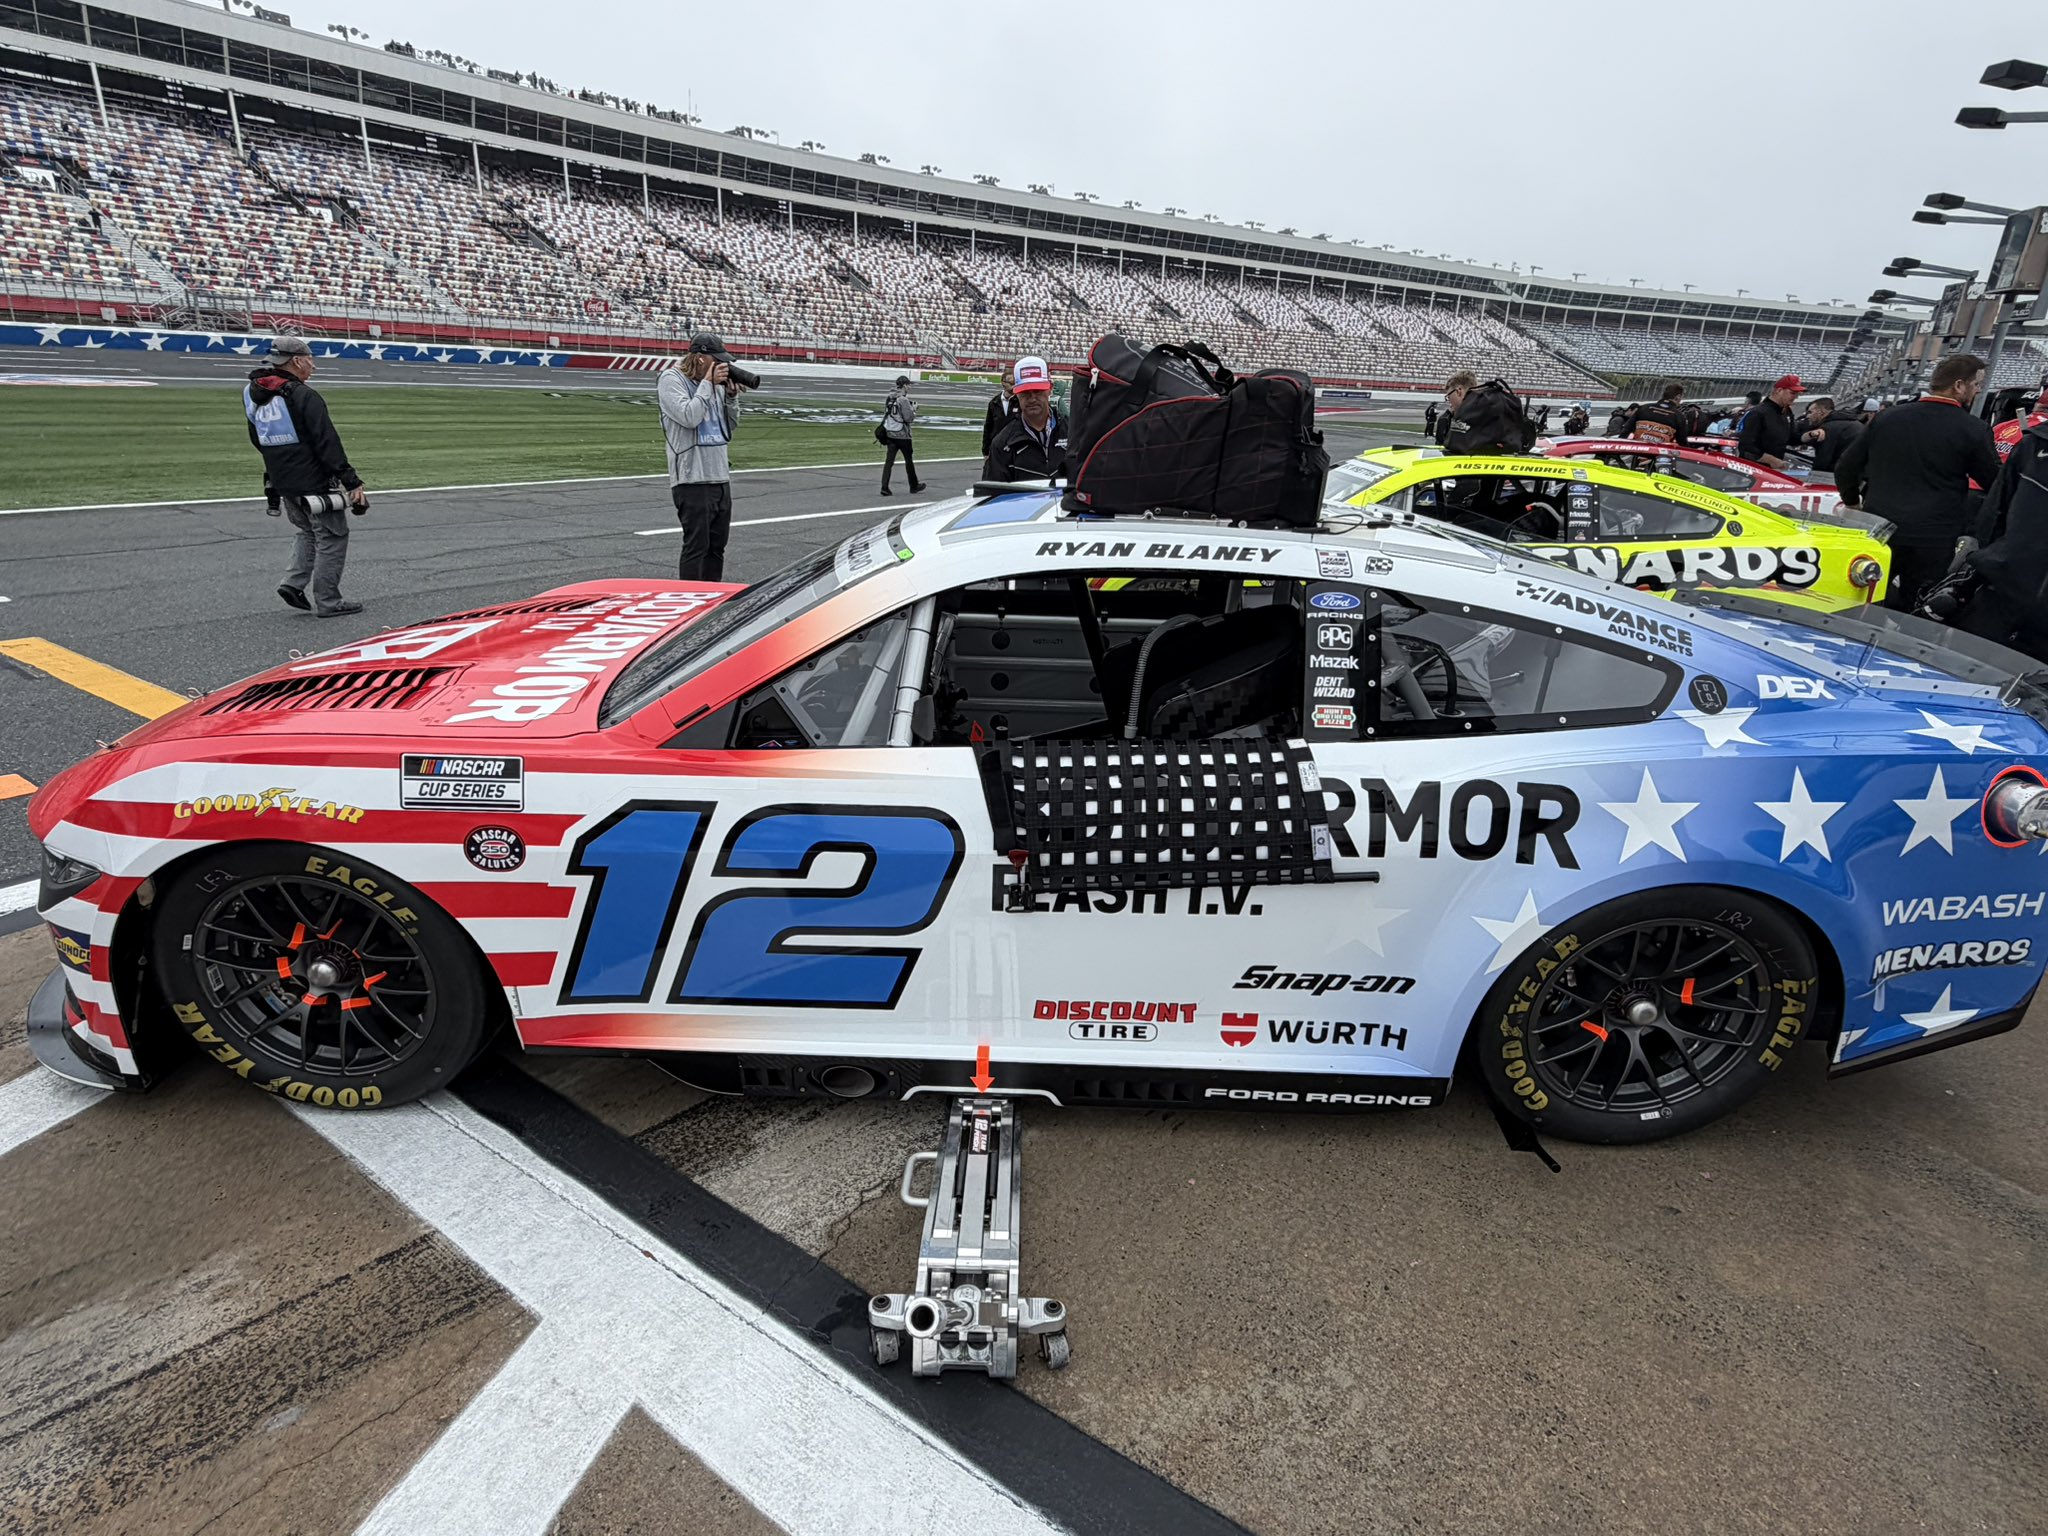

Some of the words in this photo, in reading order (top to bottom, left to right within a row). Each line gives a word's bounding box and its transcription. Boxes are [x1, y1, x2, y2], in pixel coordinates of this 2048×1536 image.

[1453, 463, 1505, 471] AUSTIN
[1510, 465, 1567, 475] CINDRIC
[1662, 485, 1731, 511] FREIGHTLINER
[1035, 541, 1136, 558] RYAN
[1144, 543, 1284, 563] BLANEY
[1530, 546, 1818, 585] ENARDS
[1320, 594, 1351, 606] Ford
[1306, 612, 1364, 620] RACING
[1549, 591, 1693, 647] ADVANCE
[1320, 627, 1350, 646] PPG
[1608, 623, 1646, 642] AUTO
[1650, 636, 1693, 657] PARTS
[443, 592, 725, 724] BODYARMOR
[1309, 654, 1360, 669] Mazak
[1313, 687, 1356, 698] WIZARD
[1315, 676, 1344, 687] DENT
[1756, 674, 1837, 700] DEX
[440, 760, 505, 776] NASCAR
[419, 782, 450, 797] CUP
[452, 783, 506, 798] SERIES
[174, 787, 364, 824] GOODYEAR
[472, 829, 517, 845] NASCAR
[481, 845, 509, 854] 250
[473, 854, 520, 869] SALUTES
[304, 855, 418, 930] EAGLE
[556, 799, 966, 1010] 12
[1882, 891, 2046, 927] WABASH
[1871, 938, 2032, 981] MENARDS
[1232, 965, 1417, 996] Snap-on
[1033, 999, 1197, 1024] DISCOUNT
[1500, 933, 1581, 1111] GOODYEAR
[1078, 1024, 1148, 1040] TIRE
[1268, 1019, 1408, 1051] WÜRTH
[1758, 979, 1807, 1072] EAGLE
[172, 1001, 383, 1108] GOODYEAR
[1205, 1088, 1298, 1103] FORD
[1306, 1091, 1432, 1106] RACING
[974, 1118, 988, 1131] 12
